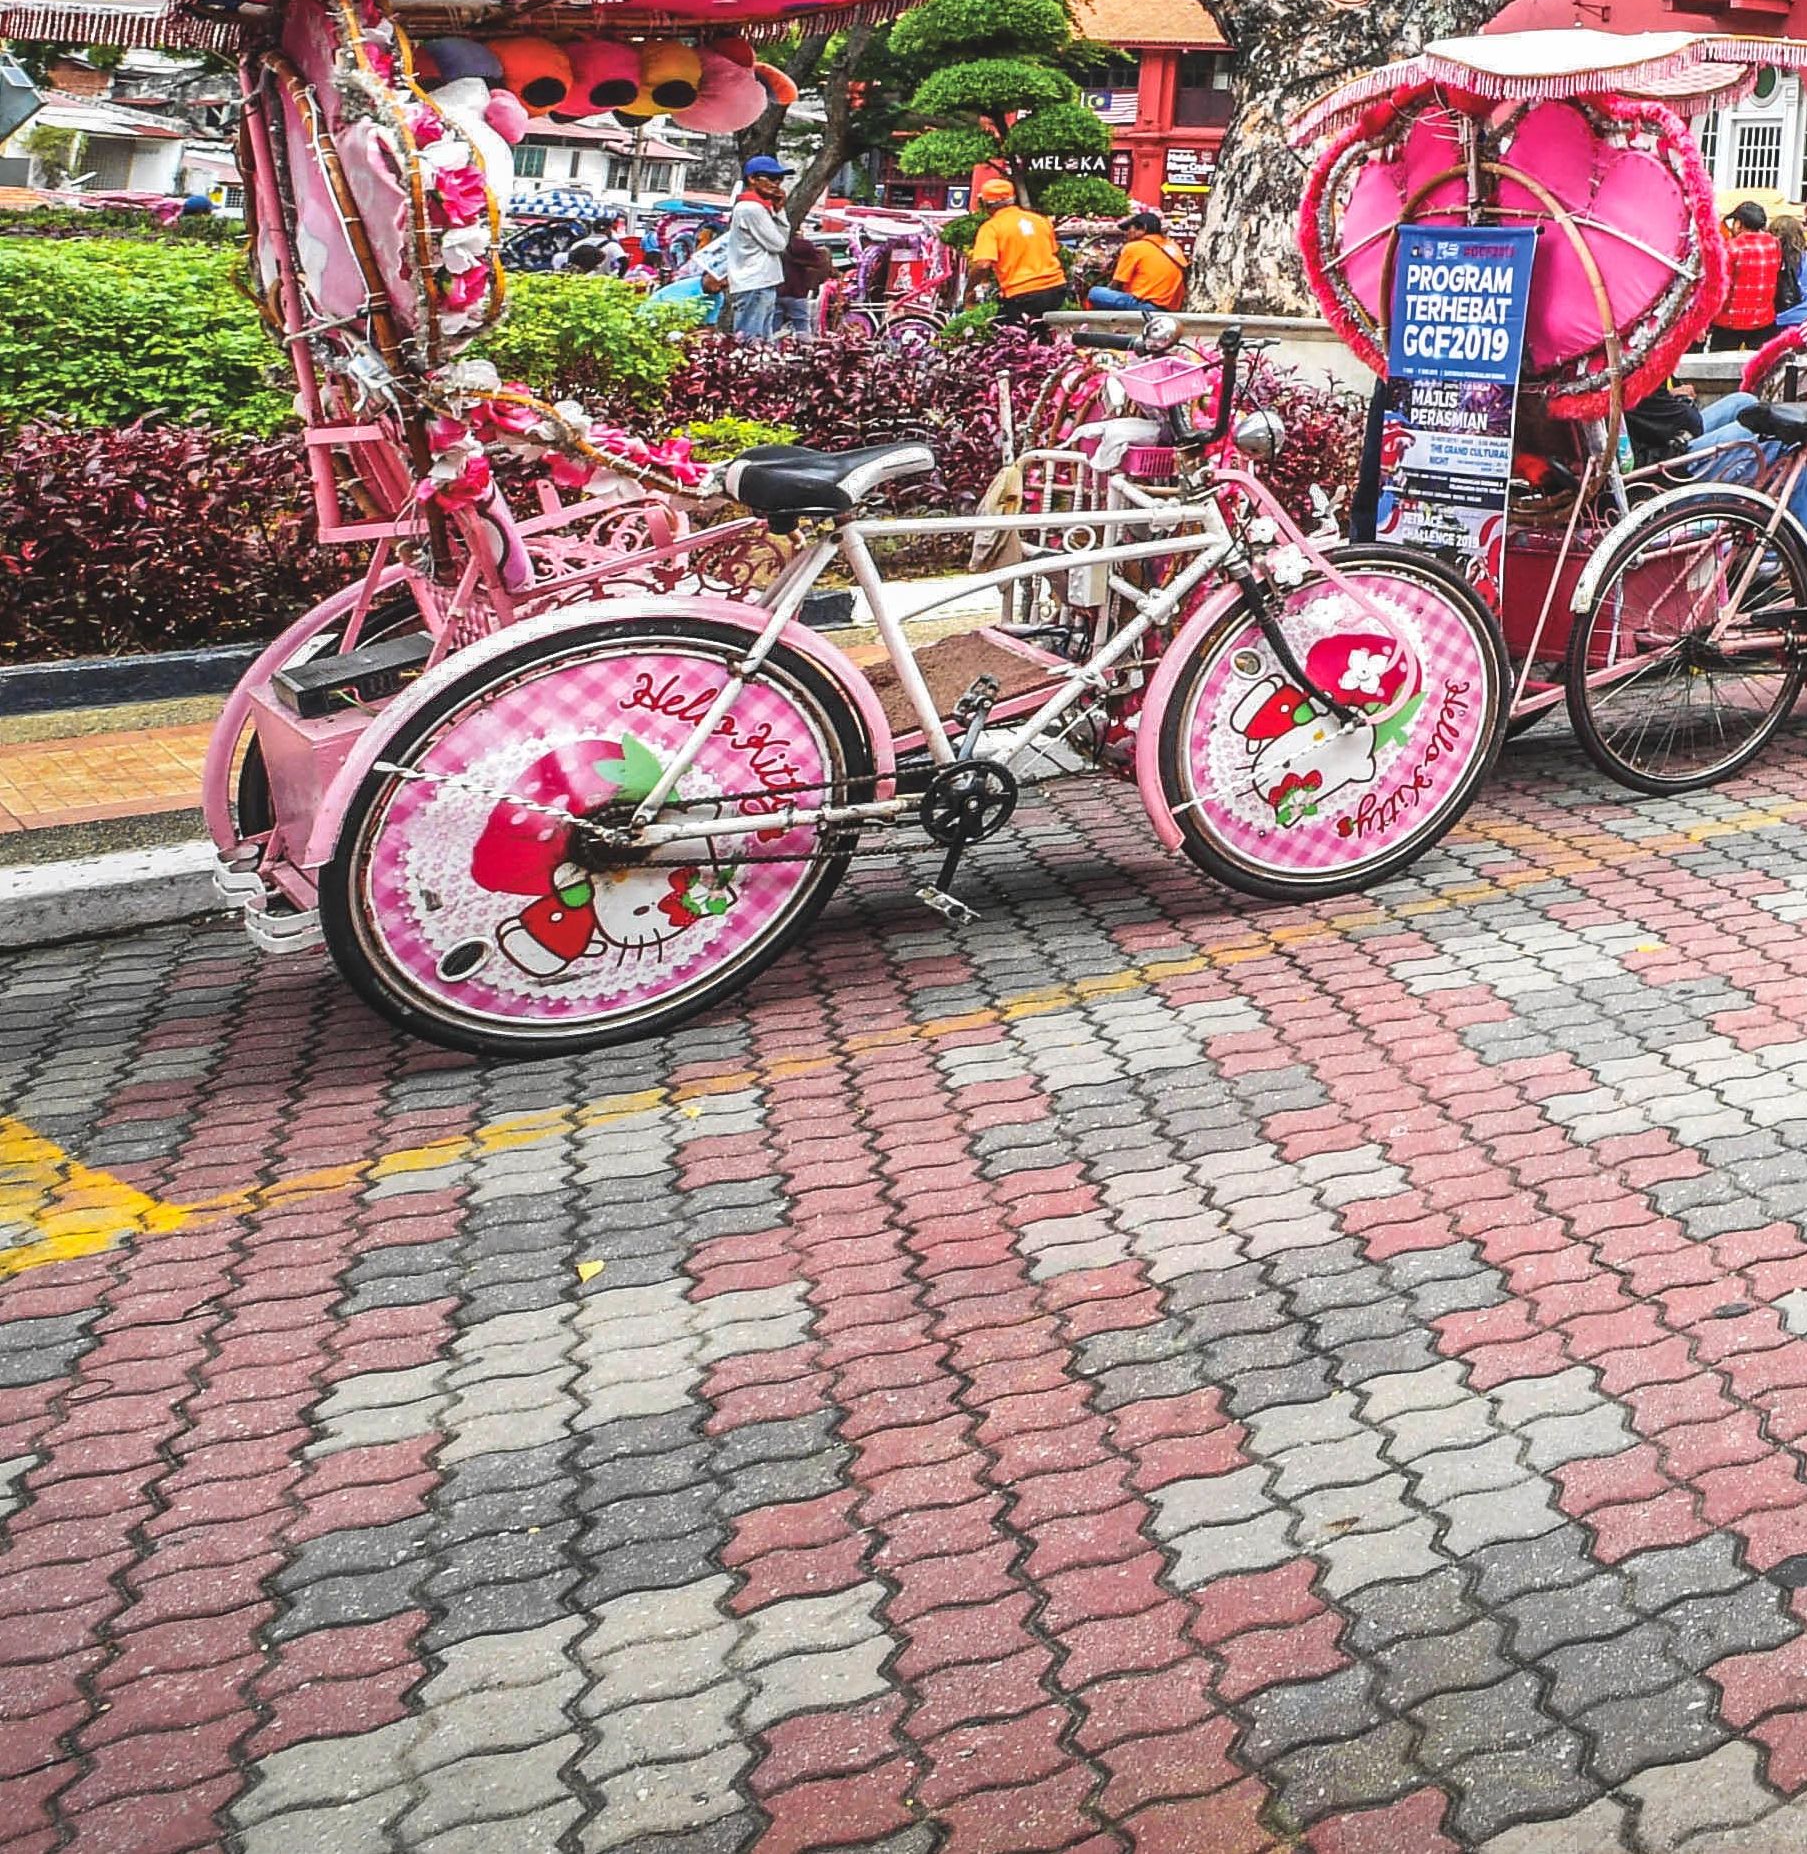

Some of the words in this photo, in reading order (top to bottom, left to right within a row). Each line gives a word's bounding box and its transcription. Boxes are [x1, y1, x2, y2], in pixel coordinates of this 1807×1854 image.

[1407, 265, 1513, 294] PROGRAM
[1406, 294, 1512, 324] TERHEBAT
[1403, 325, 1509, 362] GCF2019
[1411, 389, 1458, 408] MAJLIS
[1410, 408, 1488, 431] PERASMIAN
[1469, 447, 1508, 459] CULTURAL
[1424, 678, 1470, 768] Hello
[1357, 764, 1433, 839] Kitty
